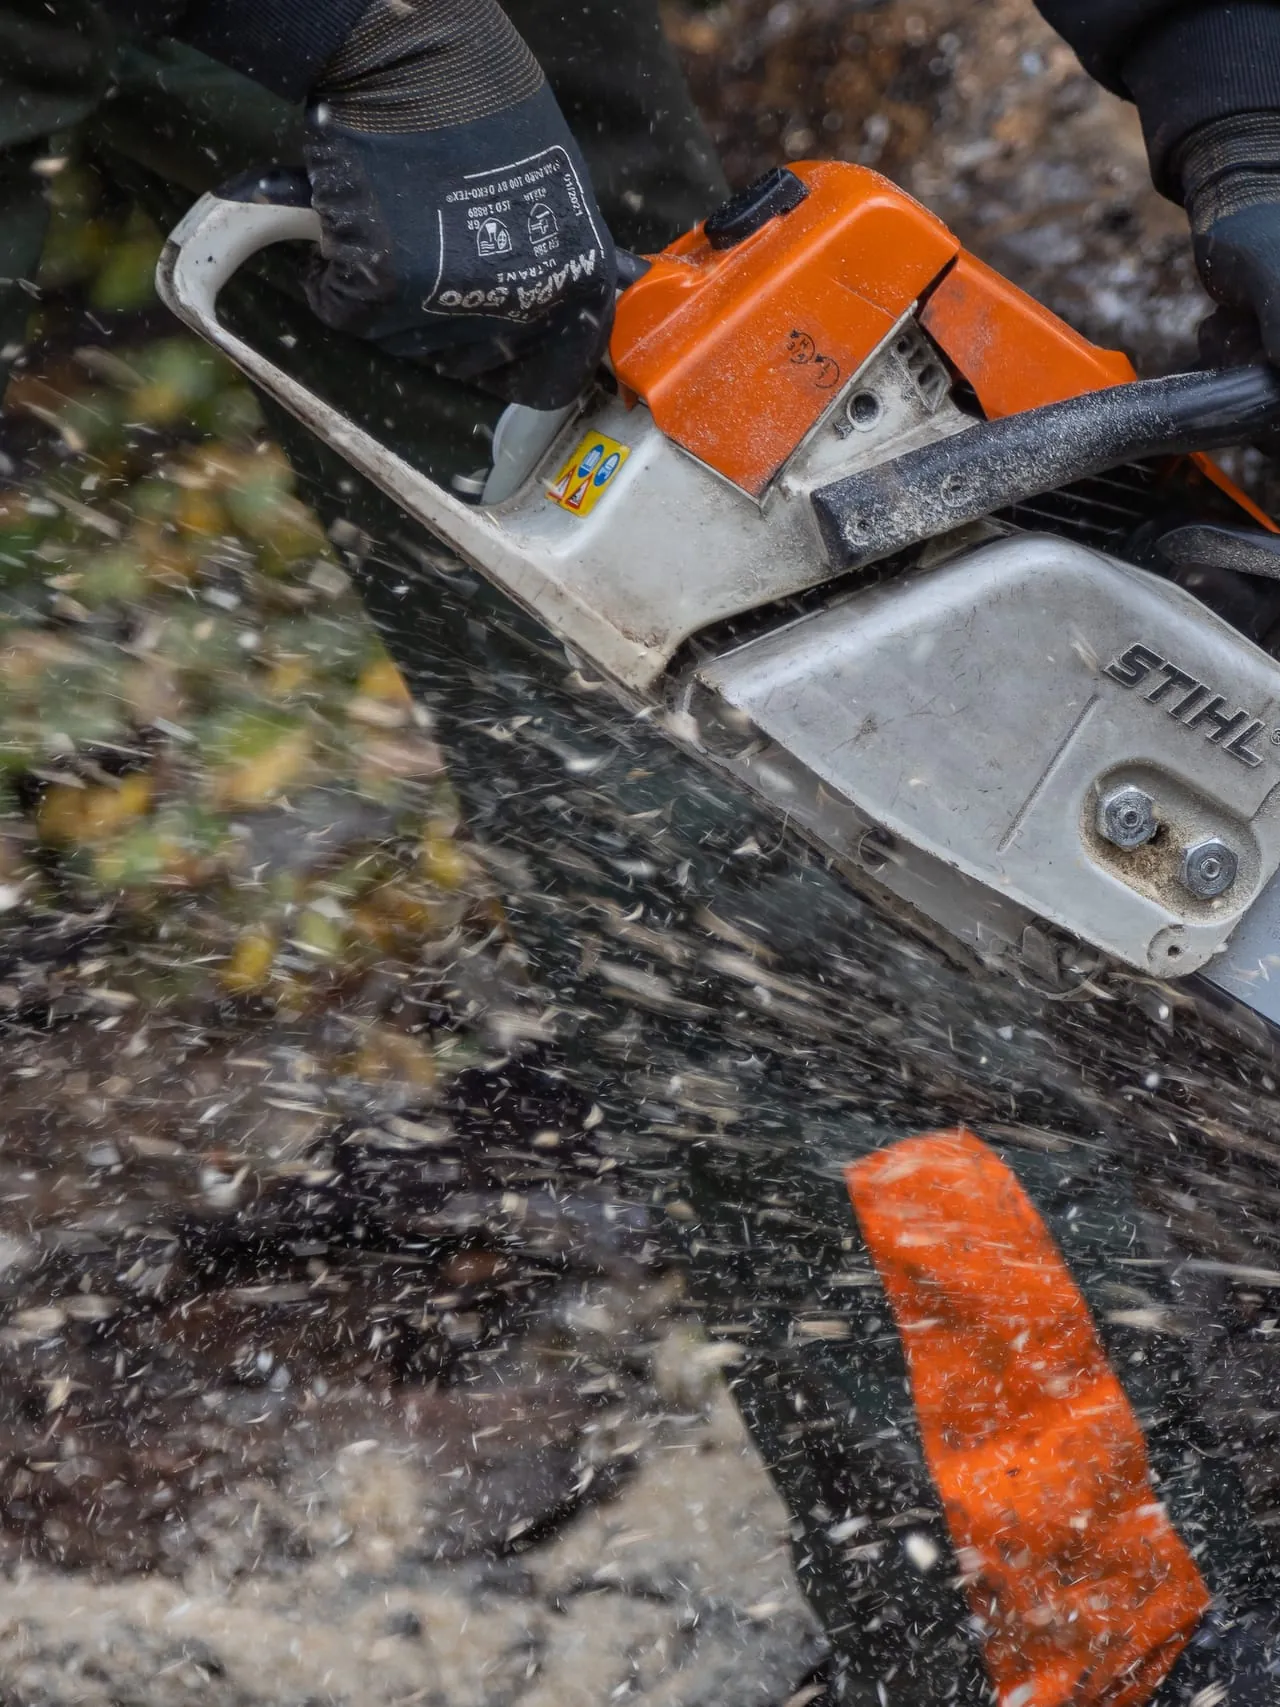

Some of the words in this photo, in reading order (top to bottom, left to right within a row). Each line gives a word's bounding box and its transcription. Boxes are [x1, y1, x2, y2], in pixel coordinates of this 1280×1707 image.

[498, 181, 508, 193] BY
[509, 176, 524, 189] 100
[496, 200, 511, 213] ISO
[496, 258, 557, 283] ULTRANE
[517, 249, 596, 310] MAPA
[438, 286, 509, 308] 500
